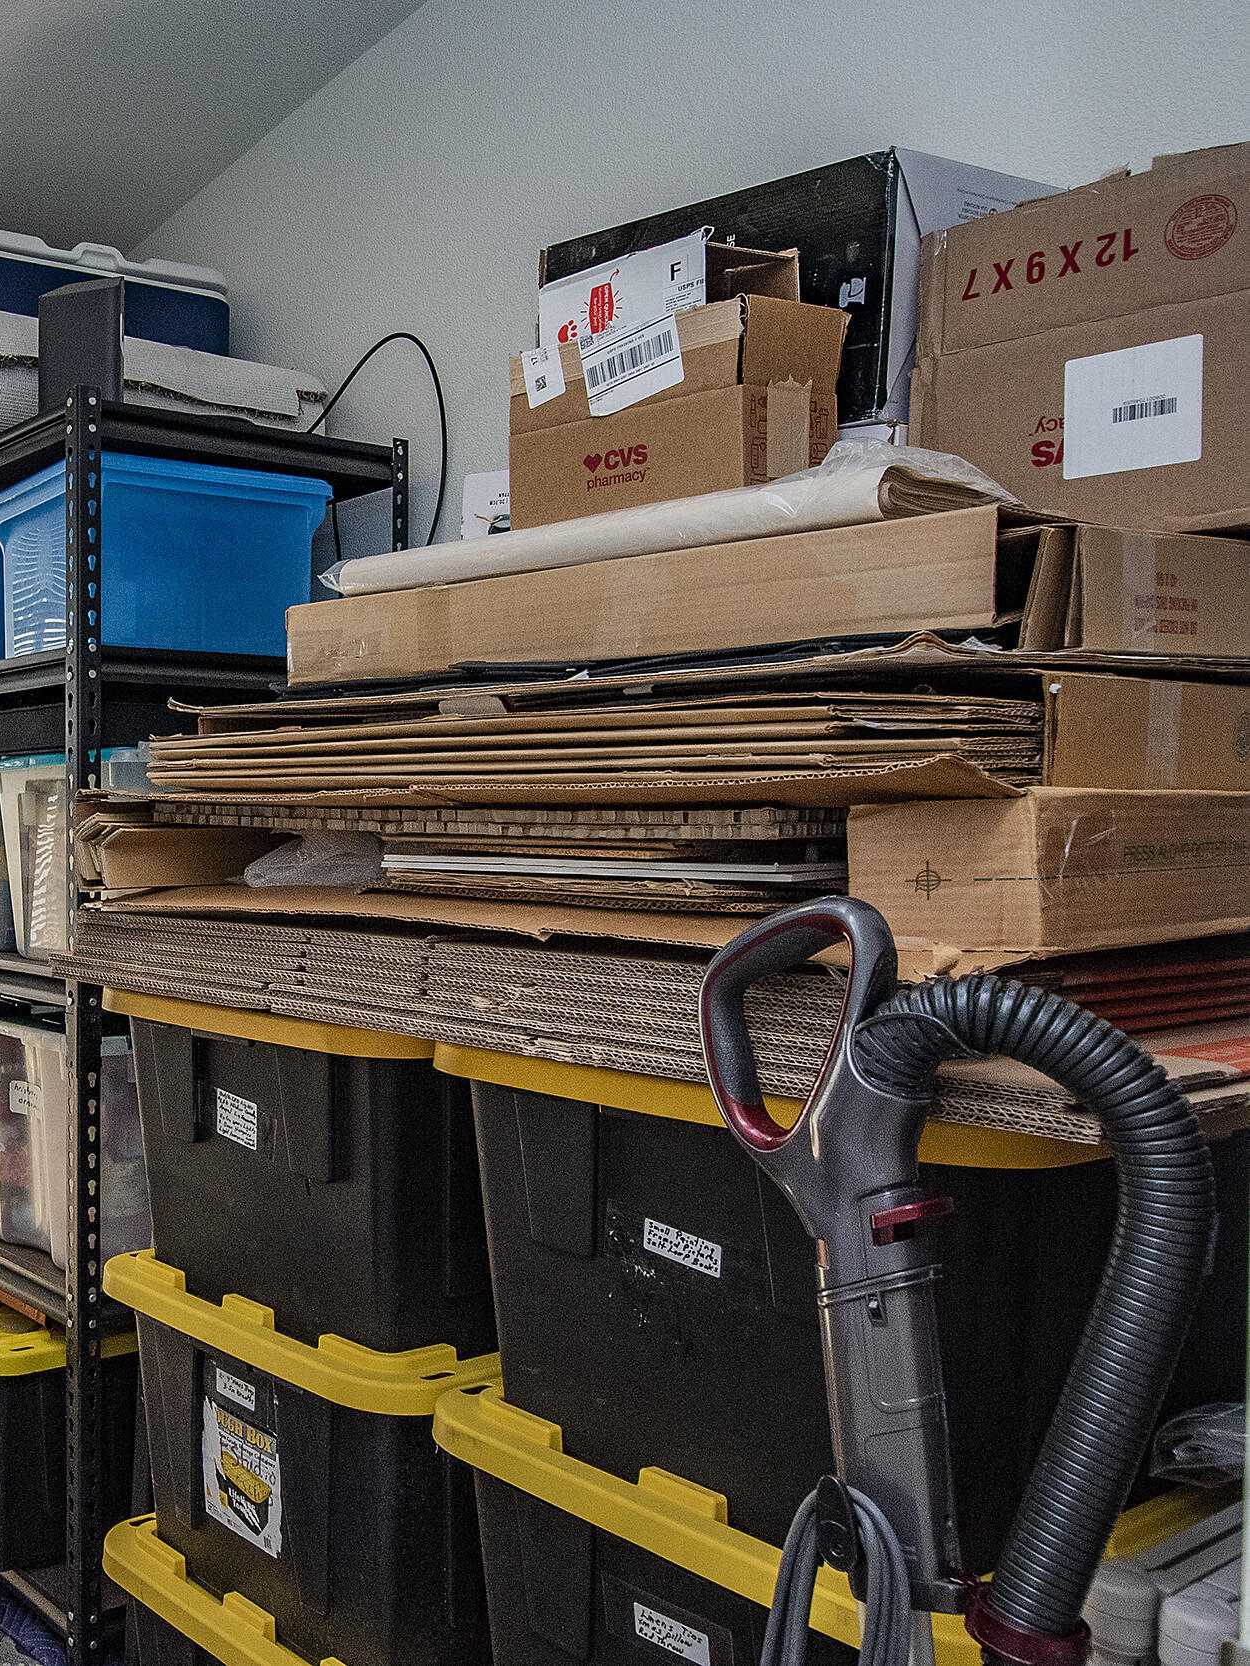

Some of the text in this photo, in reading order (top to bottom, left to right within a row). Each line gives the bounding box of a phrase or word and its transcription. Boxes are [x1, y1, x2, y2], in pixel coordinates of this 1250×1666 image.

[1095, 228, 1140, 268] 12
[670, 261, 682, 281] F
[677, 281, 695, 292] USPS
[604, 444, 648, 470] CVS
[587, 469, 647, 492] pharmacy
